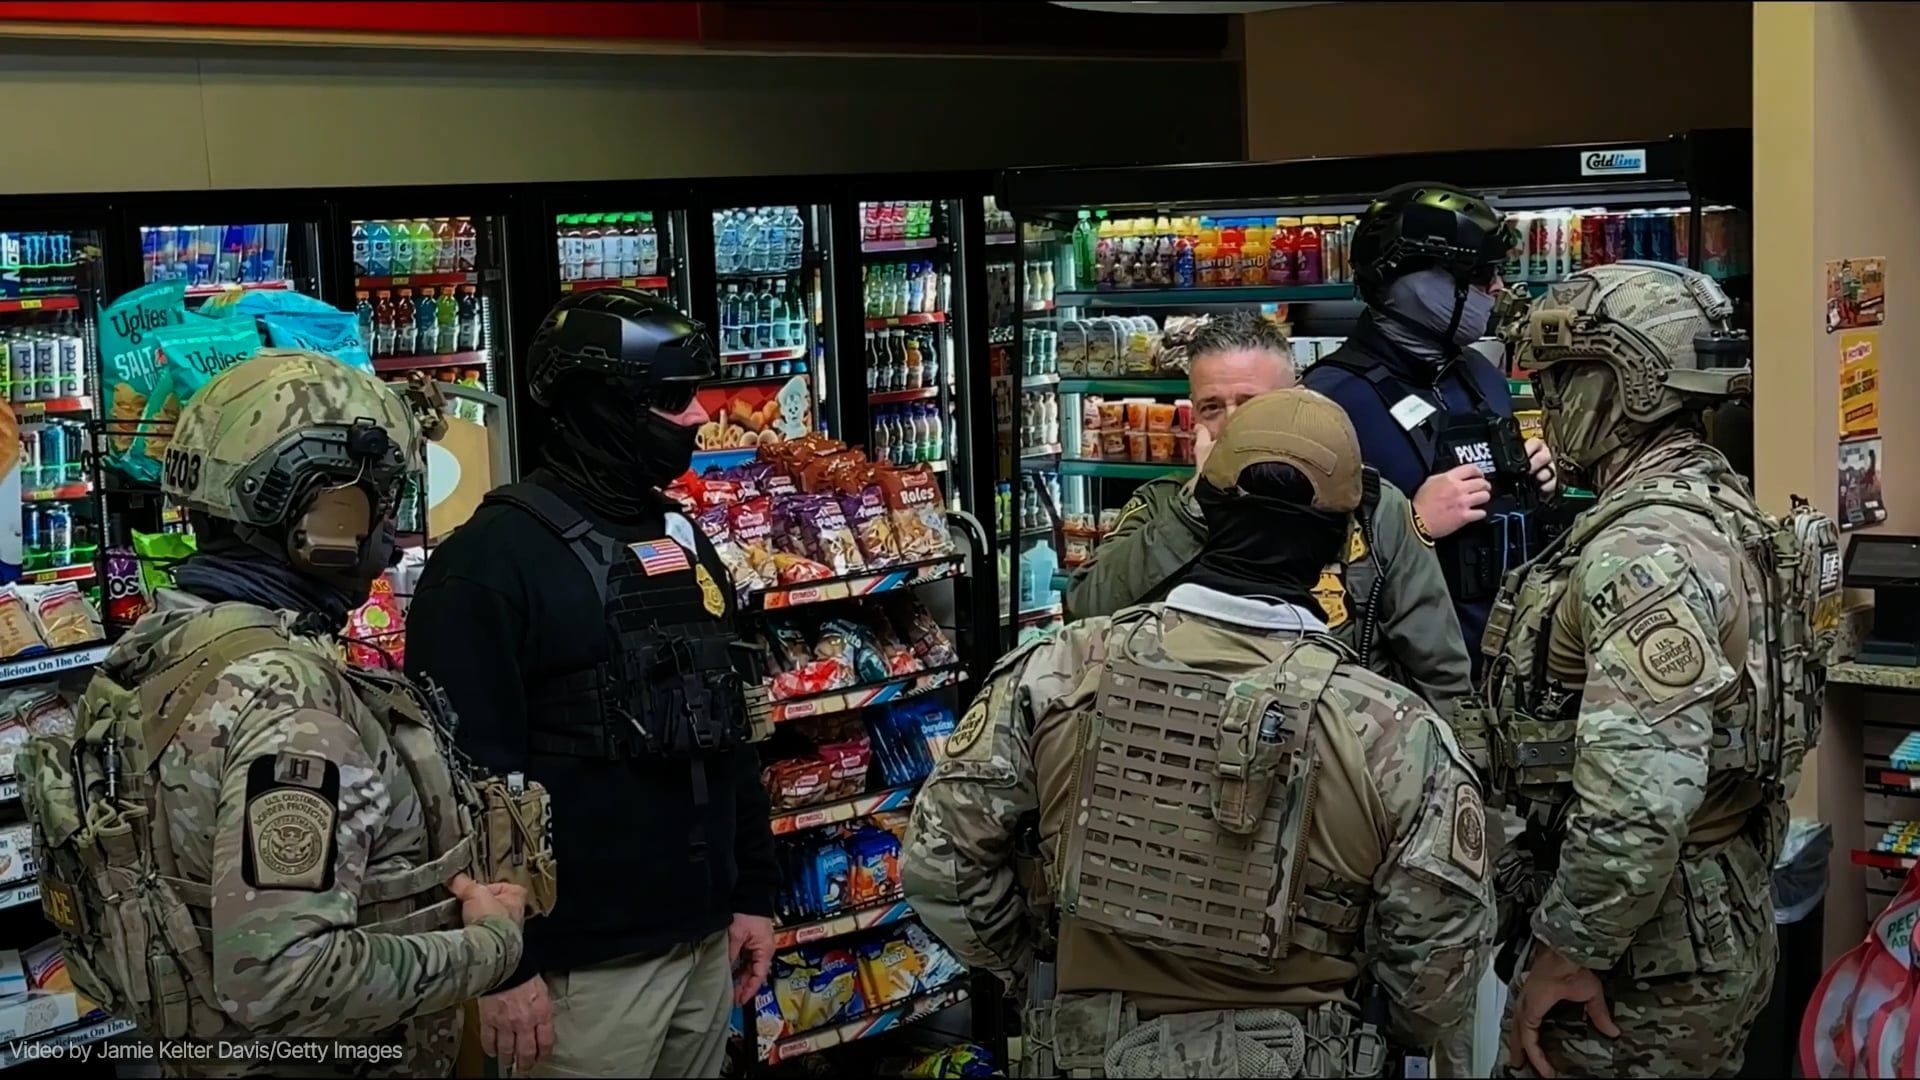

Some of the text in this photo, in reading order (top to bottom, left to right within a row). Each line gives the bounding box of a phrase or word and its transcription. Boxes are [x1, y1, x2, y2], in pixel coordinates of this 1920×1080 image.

[1586, 153, 1641, 170] Coldline
[111, 304, 168, 344] Uglies
[64, 345, 77, 391] portal
[114, 346, 153, 381] SALT
[1455, 442, 1492, 464] POLICE
[165, 448, 201, 491] AZ03
[900, 486, 935, 505] Roles
[1633, 613, 1667, 636] BORTAC
[38, 661, 53, 672] On
[56, 657, 73, 668] The
[74, 653, 90, 664] Go!
[1649, 641, 1691, 668] BORDER
[1659, 652, 1698, 677] PATROL
[281, 793, 320, 810] CUSTOMS
[89, 1026, 105, 1038] On
[107, 1021, 124, 1034] The
